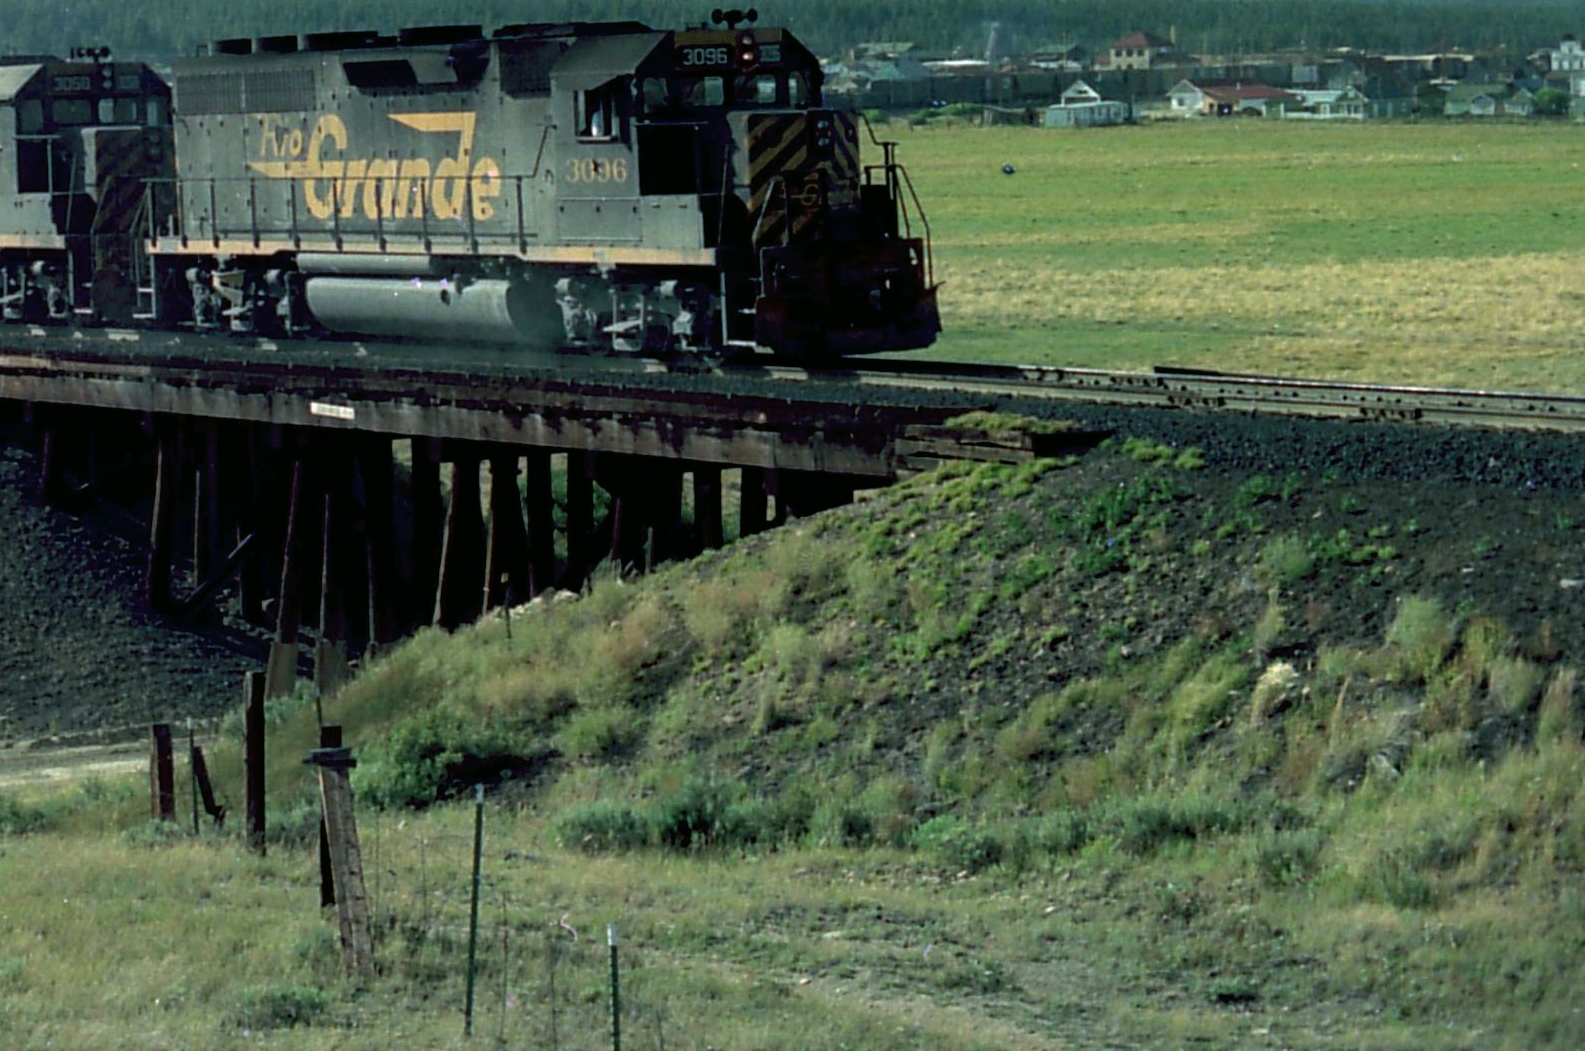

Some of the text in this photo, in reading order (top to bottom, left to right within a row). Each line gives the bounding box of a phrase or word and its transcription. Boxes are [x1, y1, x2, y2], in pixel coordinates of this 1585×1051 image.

[681, 47, 729, 67] 3096
[248, 111, 502, 221] Grande
[565, 157, 628, 183] 3096
